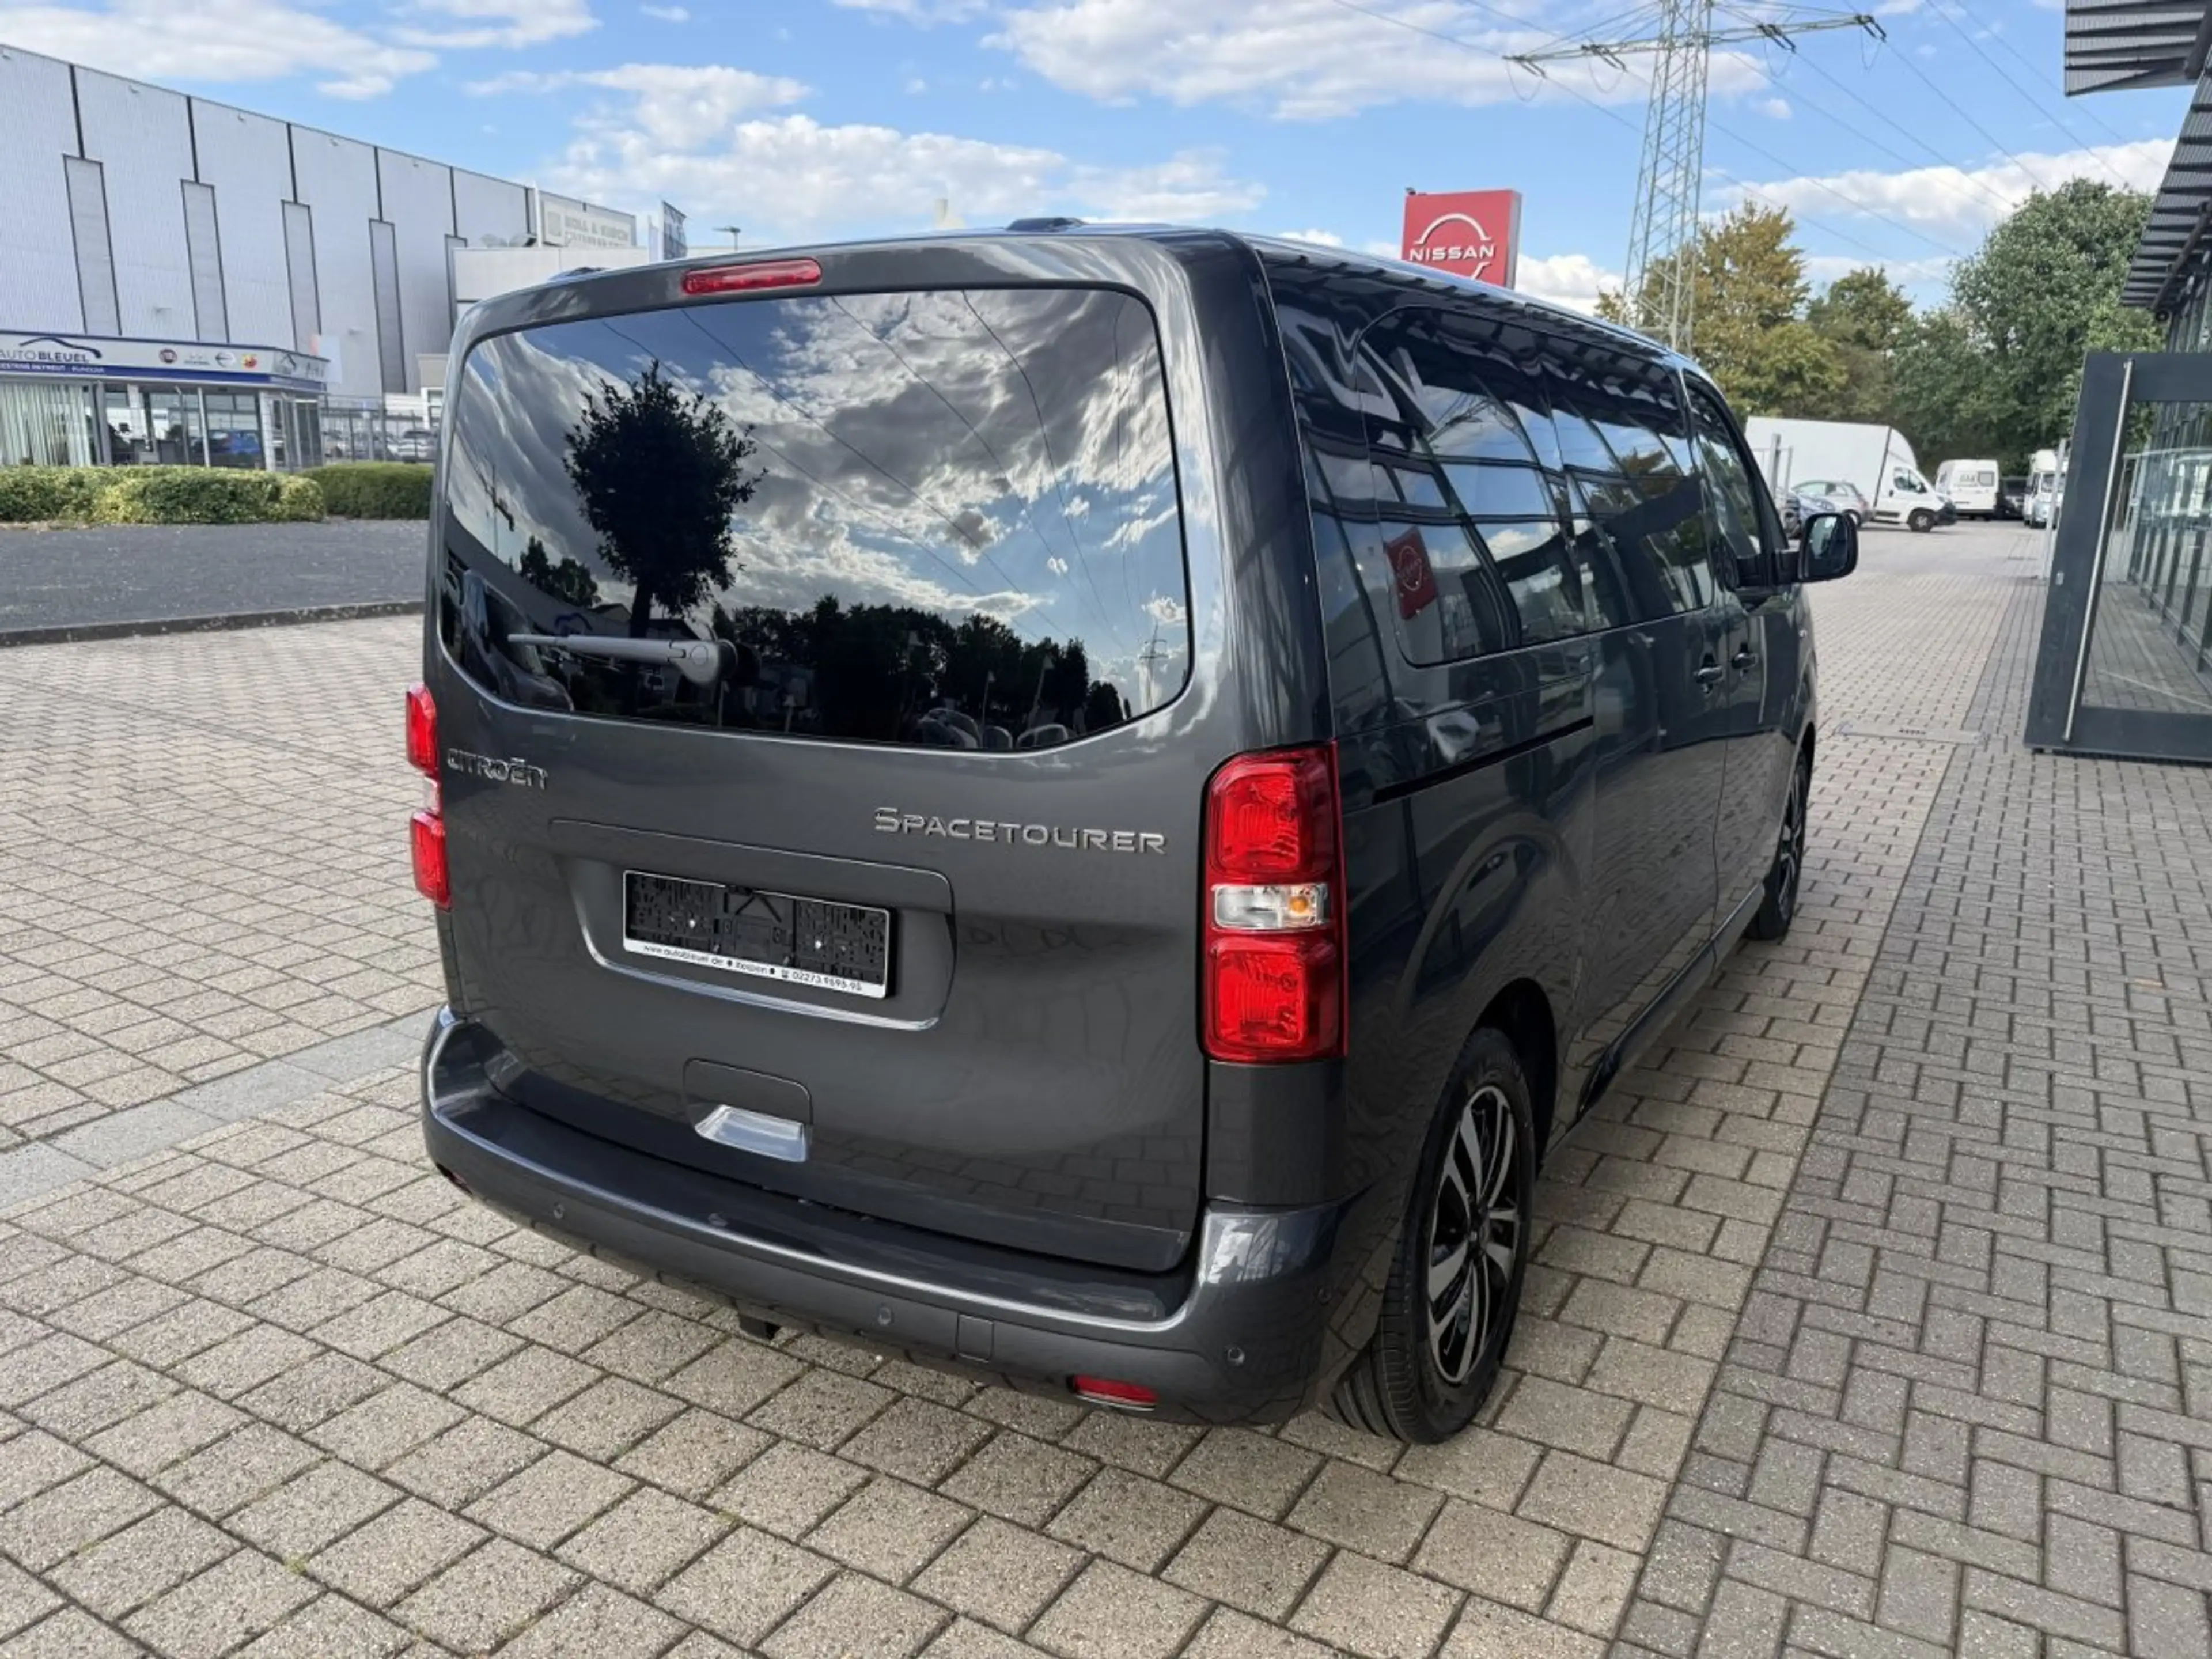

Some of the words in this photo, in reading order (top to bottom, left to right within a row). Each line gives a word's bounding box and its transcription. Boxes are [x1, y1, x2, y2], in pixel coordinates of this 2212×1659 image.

[1410, 244, 1495, 262] NISSAN
[448, 748, 548, 790] CITROËN
[874, 807, 1166, 854] SPACETOURER
